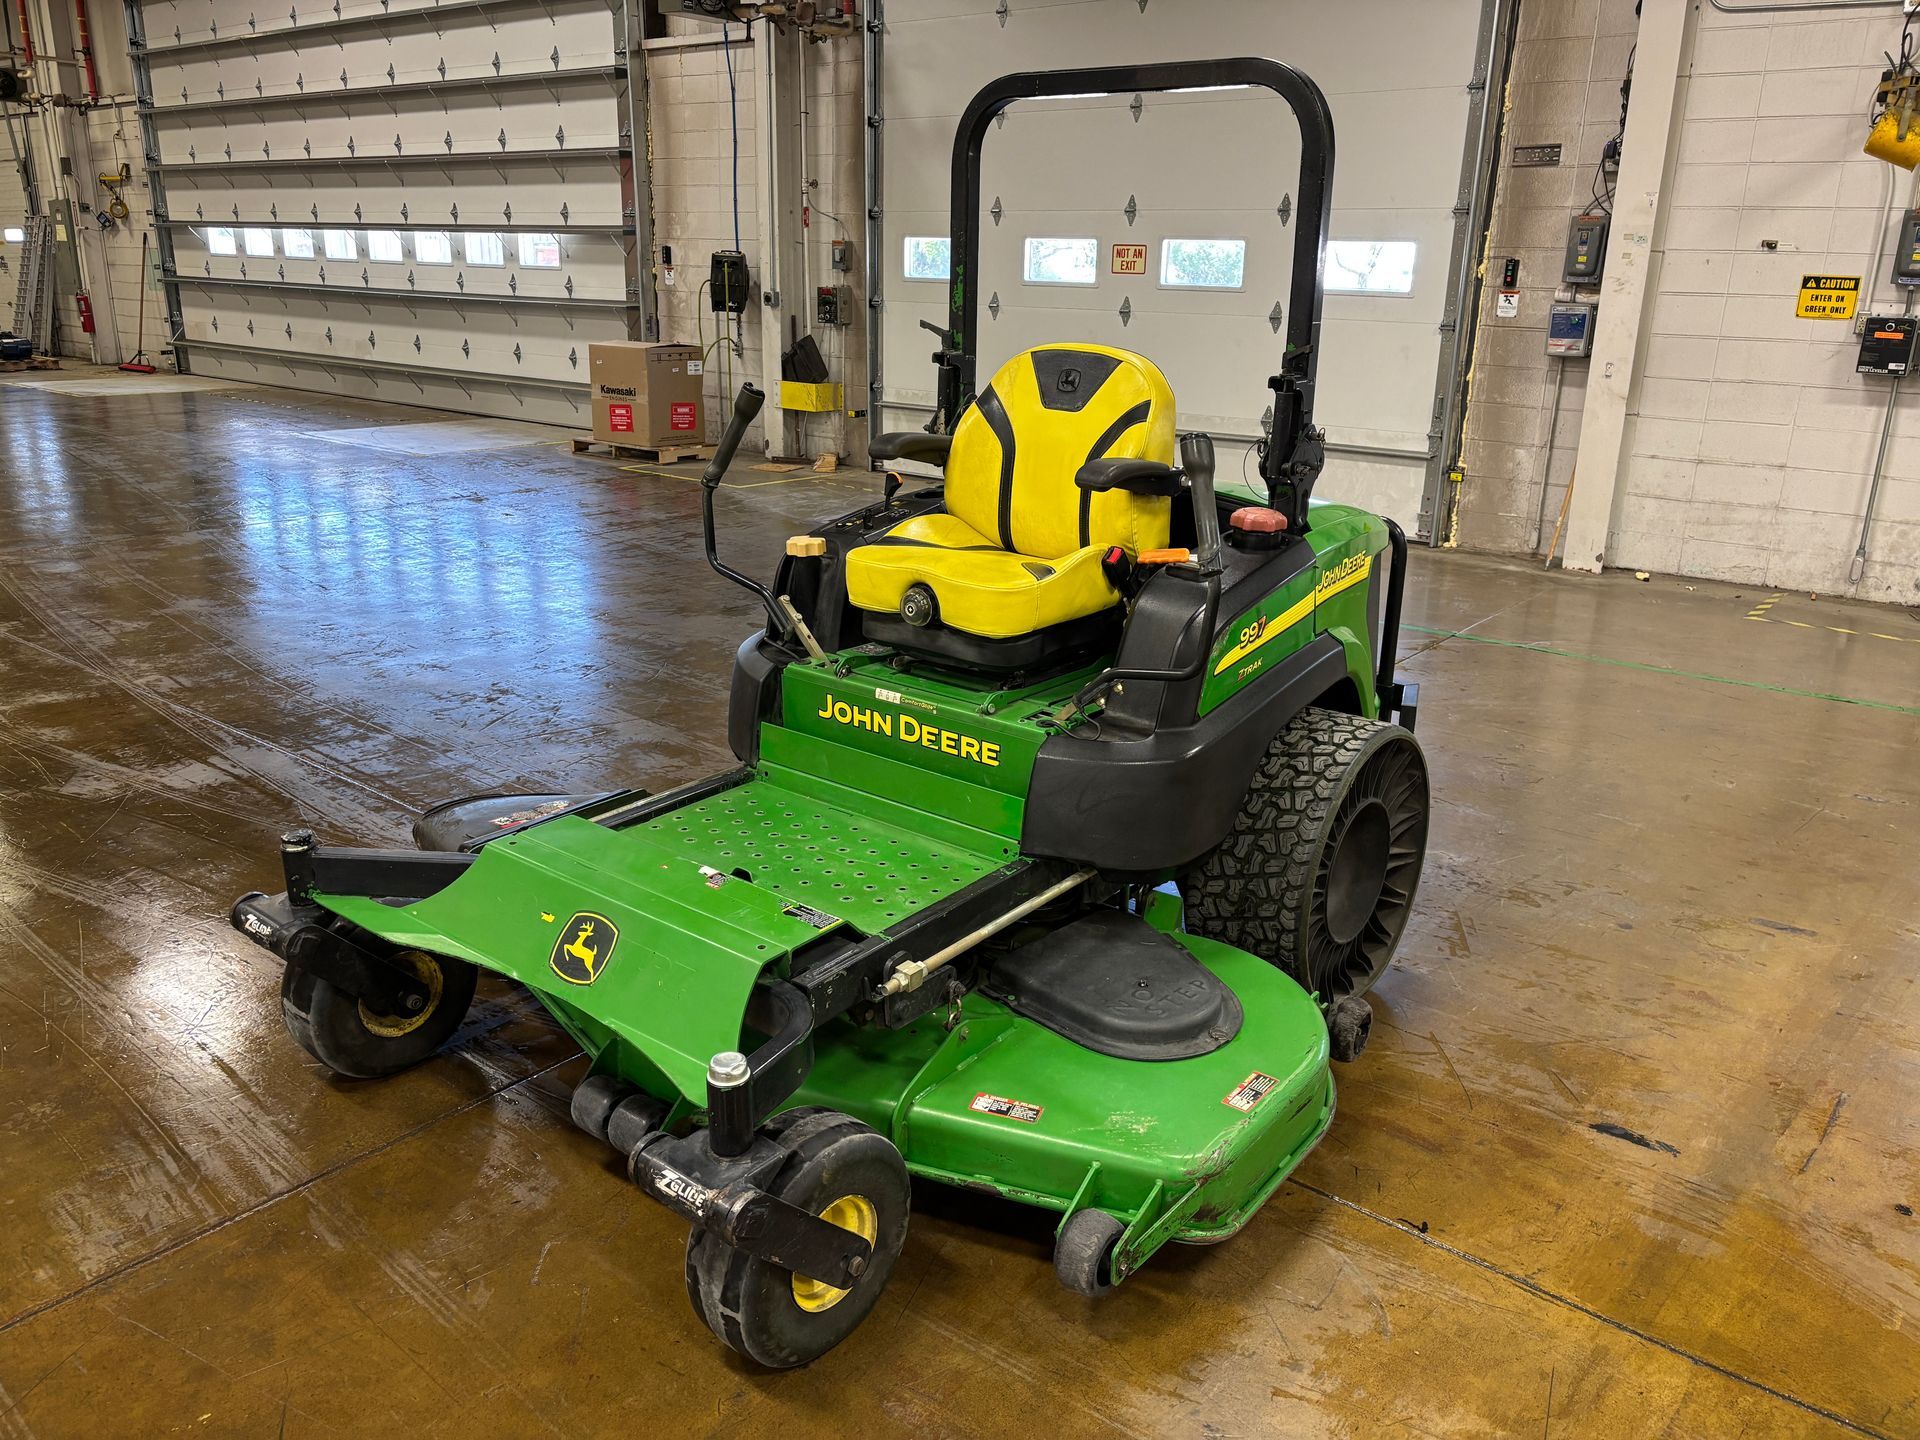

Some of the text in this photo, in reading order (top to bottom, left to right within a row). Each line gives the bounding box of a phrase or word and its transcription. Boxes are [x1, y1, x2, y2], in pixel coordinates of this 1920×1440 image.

[1116, 248, 1143, 259] NOT AN
[1120, 260, 1137, 271] EXIT
[1820, 278, 1856, 289] CAUTION
[1804, 305, 1846, 314] GREEN ONLY
[1810, 294, 1845, 303] ENTER ON
[600, 384, 637, 397] Kawasaki
[1318, 550, 1366, 593] JOHN DEERE
[1240, 614, 1267, 650] 997
[1238, 657, 1264, 681] ZTRAK
[817, 693, 1001, 768] JOHN DEERE
[1104, 989, 1154, 1017] NO
[1144, 979, 1207, 1018] STEP
[655, 1169, 706, 1208] ZGLIDE
